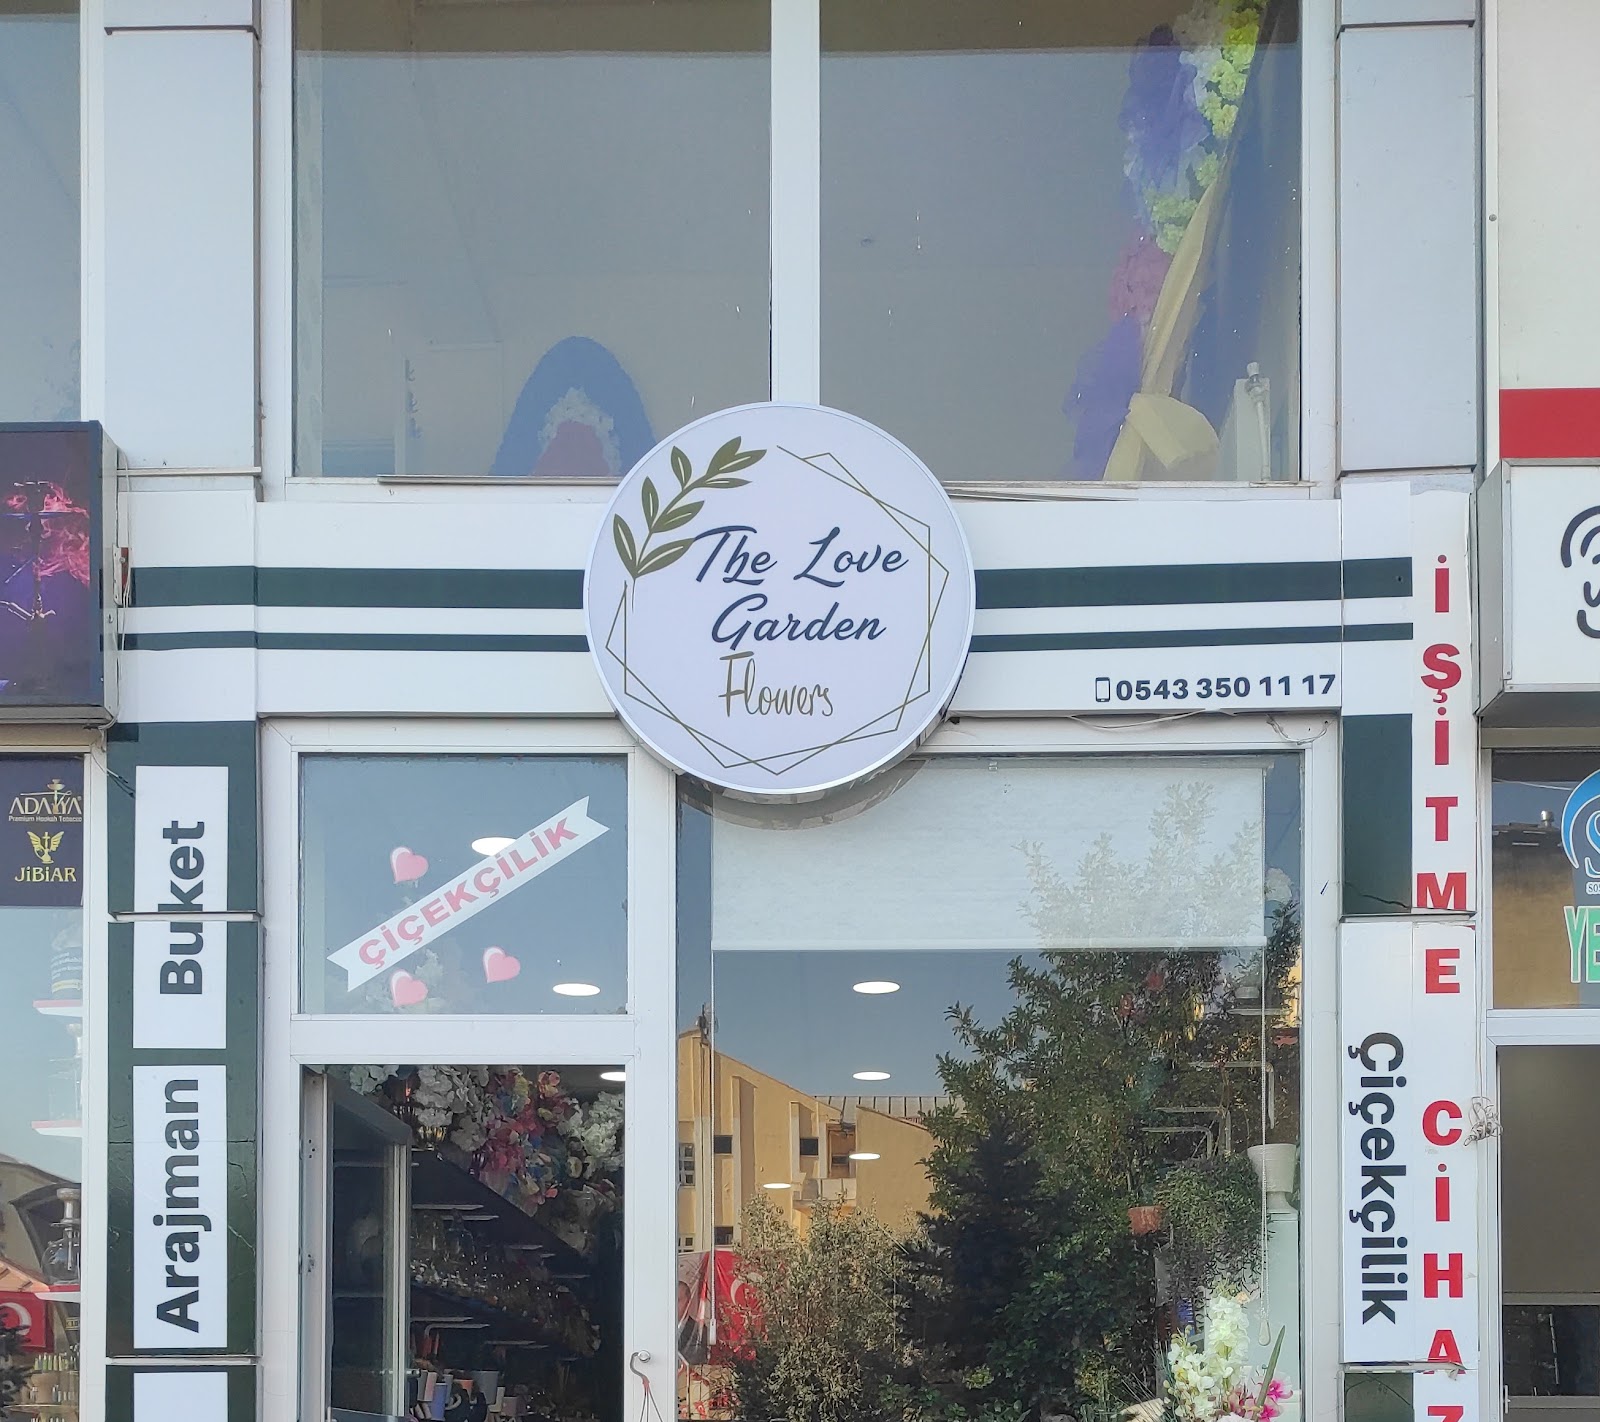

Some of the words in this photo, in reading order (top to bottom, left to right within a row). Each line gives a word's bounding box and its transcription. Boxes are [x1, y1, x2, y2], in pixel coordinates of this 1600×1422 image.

[694, 525, 778, 586] The
[793, 526, 910, 588] Love
[711, 593, 886, 651] Garden
[718, 651, 834, 718] Flowers
[1116, 679, 1189, 701] 0543
[1196, 677, 1251, 699] 350
[1259, 675, 1291, 697] 11
[1302, 674, 1336, 695] 17
[1417, 555, 1467, 995] İŞİTME
[159, 820, 206, 995] Buket
[358, 817, 581, 972] ÇİÇEKÇİLİK
[153, 1078, 212, 1333] Arajman
[1348, 1032, 1408, 1325] Çiçekçilik
